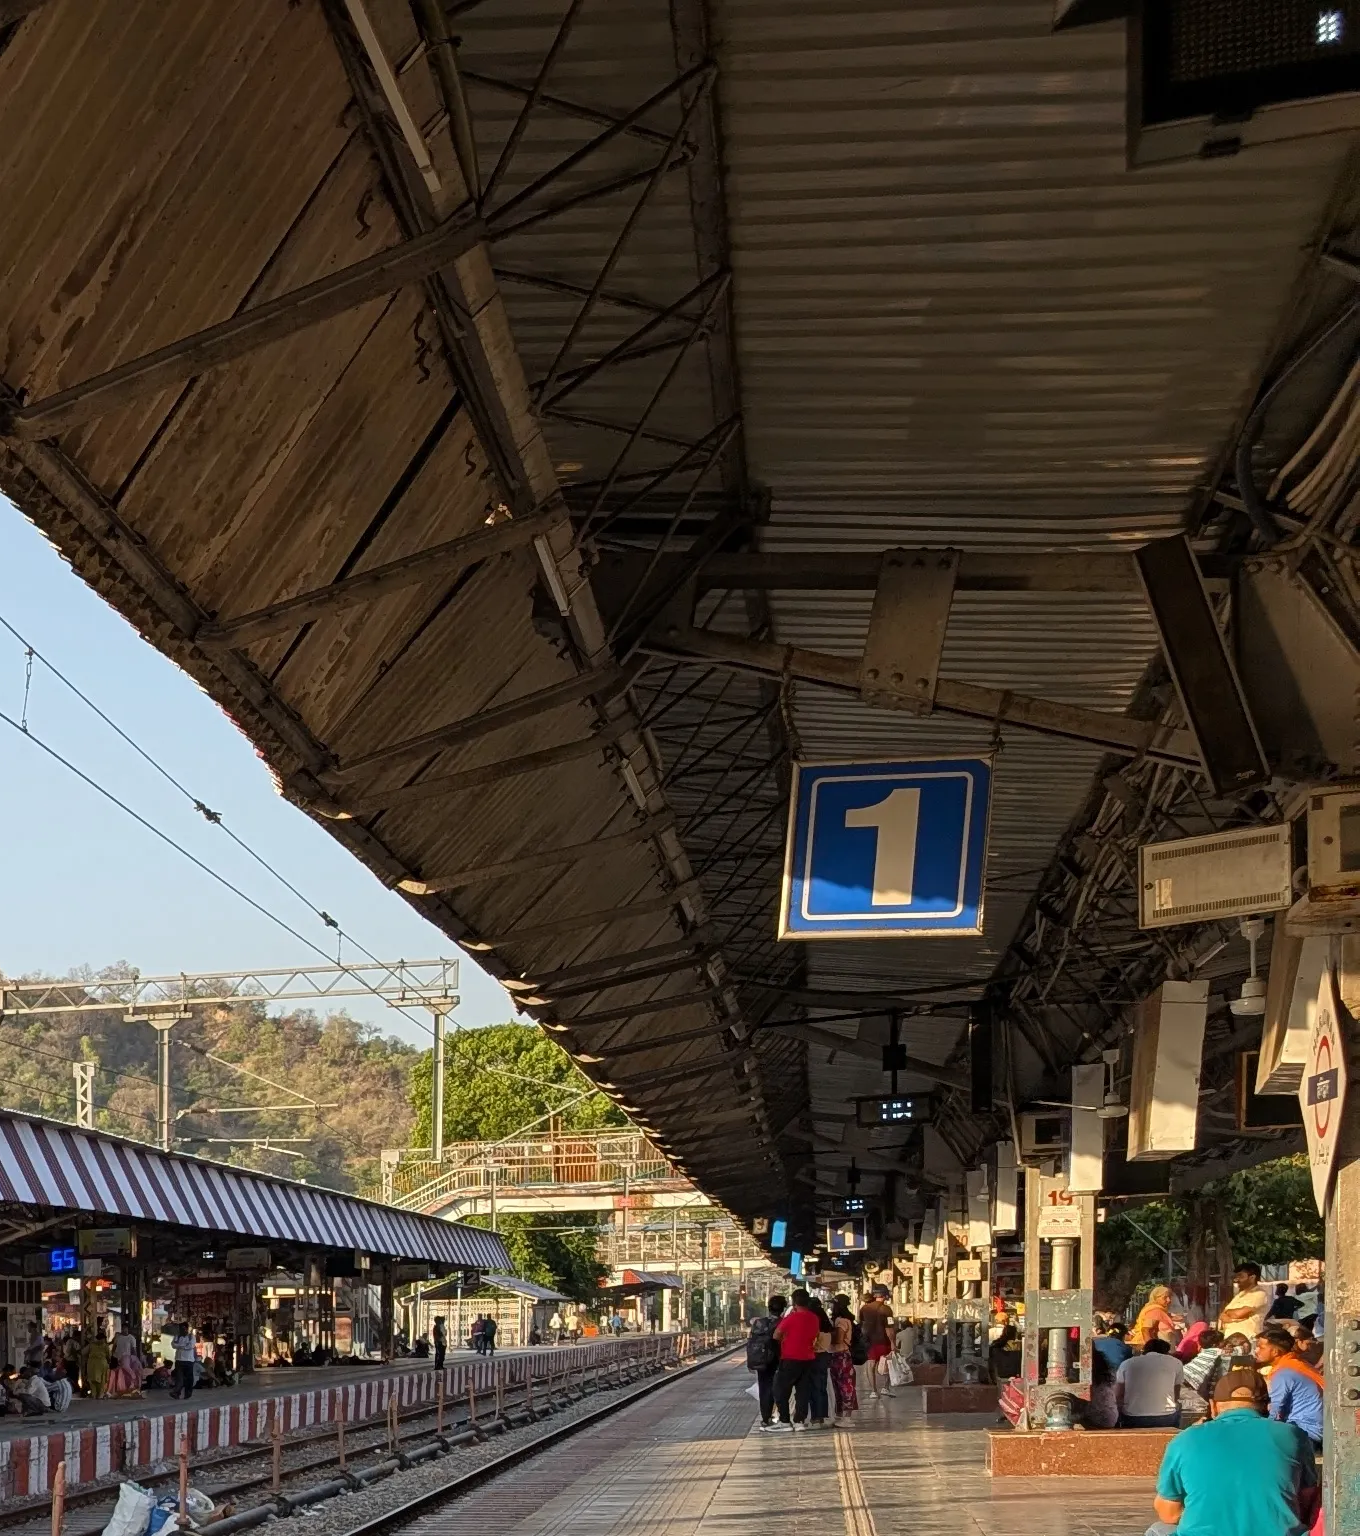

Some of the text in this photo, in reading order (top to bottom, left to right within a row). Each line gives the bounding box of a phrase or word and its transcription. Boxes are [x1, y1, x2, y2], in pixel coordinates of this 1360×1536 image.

[845, 788, 921, 906] 1
[837, 1221, 855, 1247] 1
[466, 1271, 478, 1284] 2
